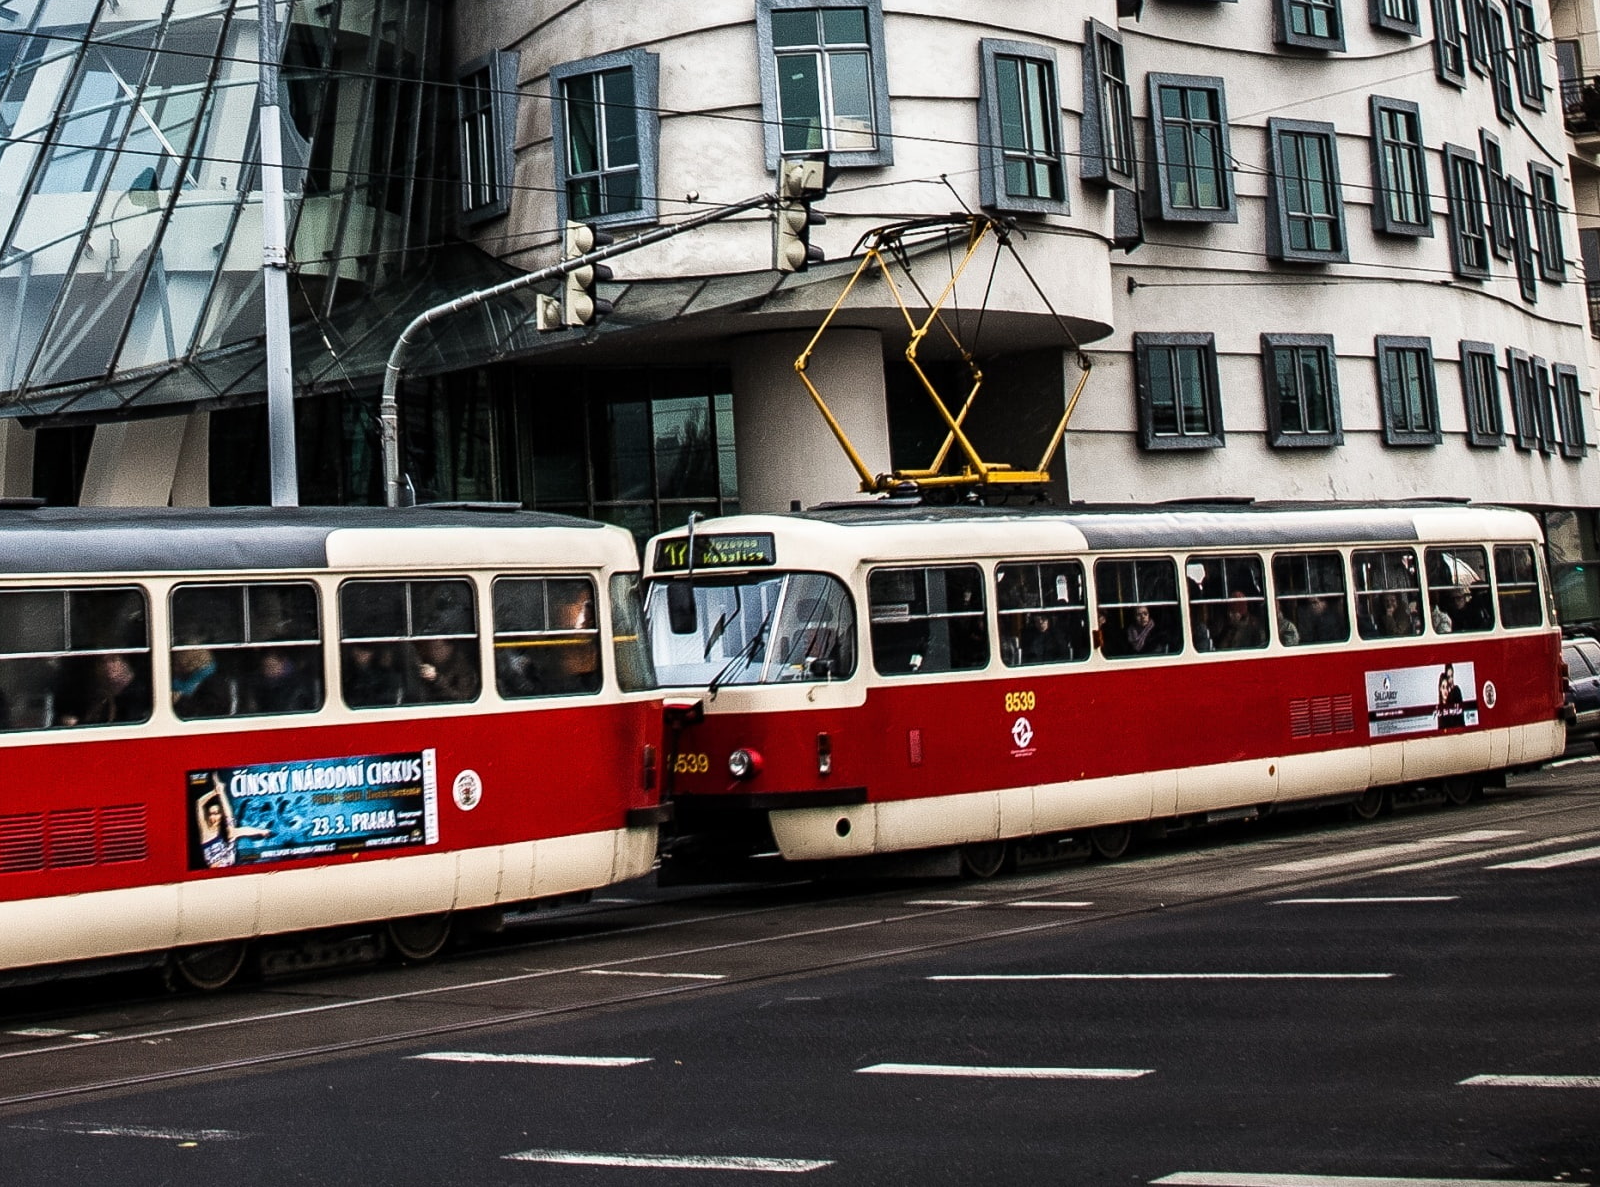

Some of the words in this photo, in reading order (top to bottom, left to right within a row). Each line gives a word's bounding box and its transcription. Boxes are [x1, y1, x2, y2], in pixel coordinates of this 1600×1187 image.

[1005, 690, 1036, 713] 8539
[230, 766, 289, 798] ČÍNSKÝ
[291, 759, 365, 793] NÁRODNÍ
[366, 758, 422, 785] CIRKUS
[351, 809, 397, 832] PRAHA
